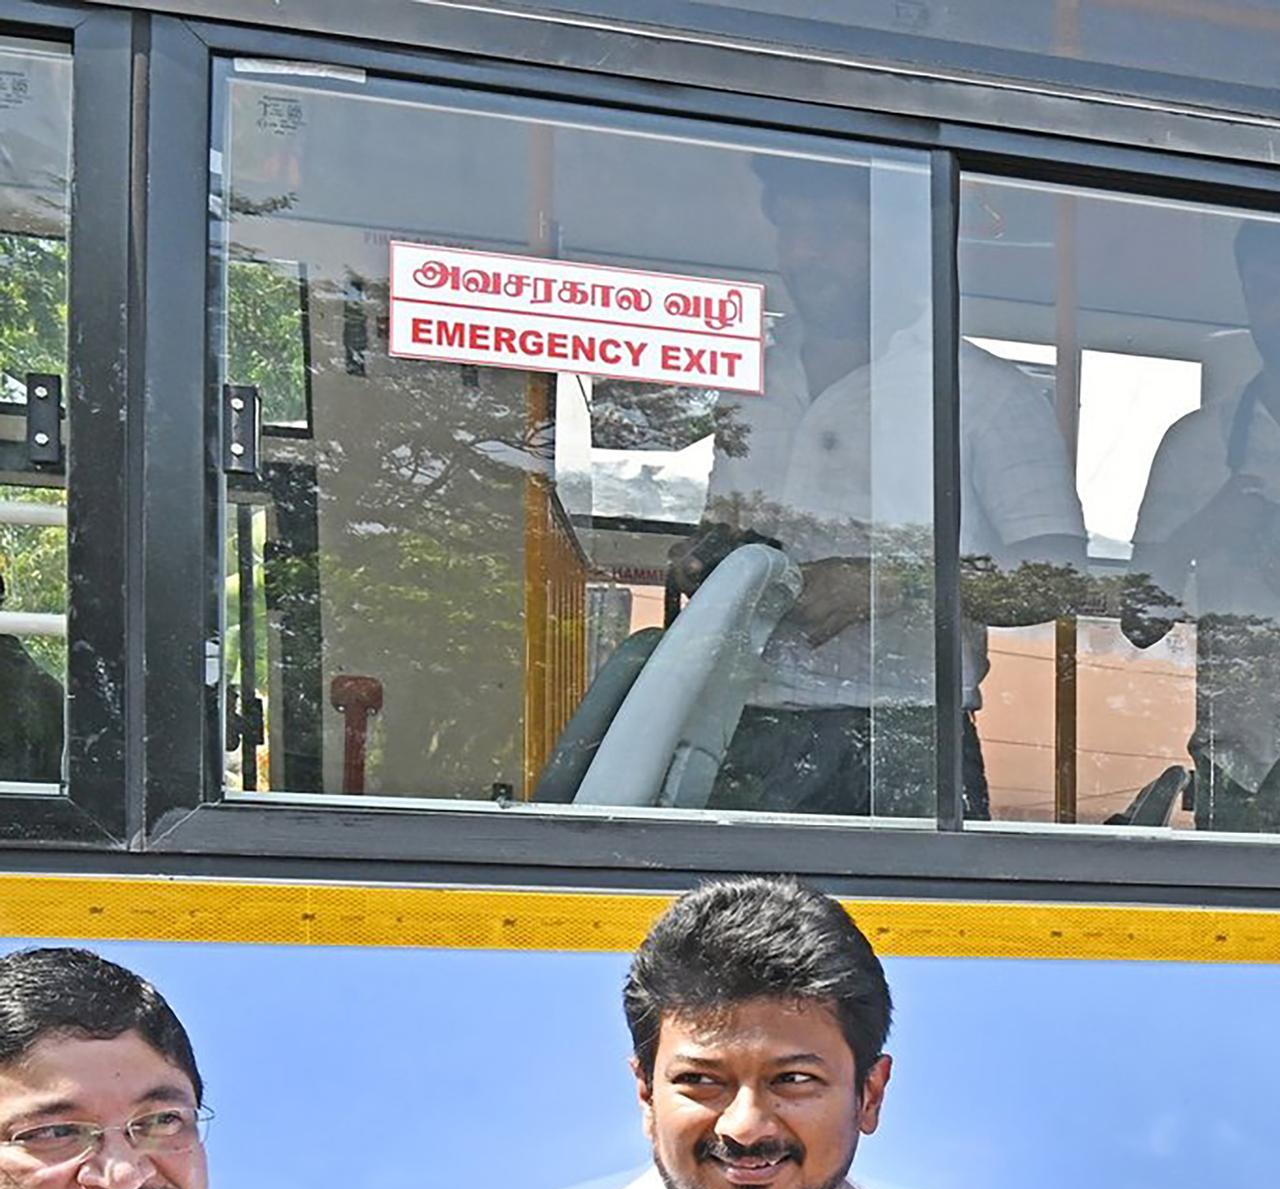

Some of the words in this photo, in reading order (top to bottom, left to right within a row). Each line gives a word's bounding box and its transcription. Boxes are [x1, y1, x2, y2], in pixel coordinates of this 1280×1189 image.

[413, 261, 651, 312] அவசரகால
[664, 288, 743, 330] வழி
[411, 317, 647, 368] EMERGENCY
[661, 345, 743, 377] EXIT
